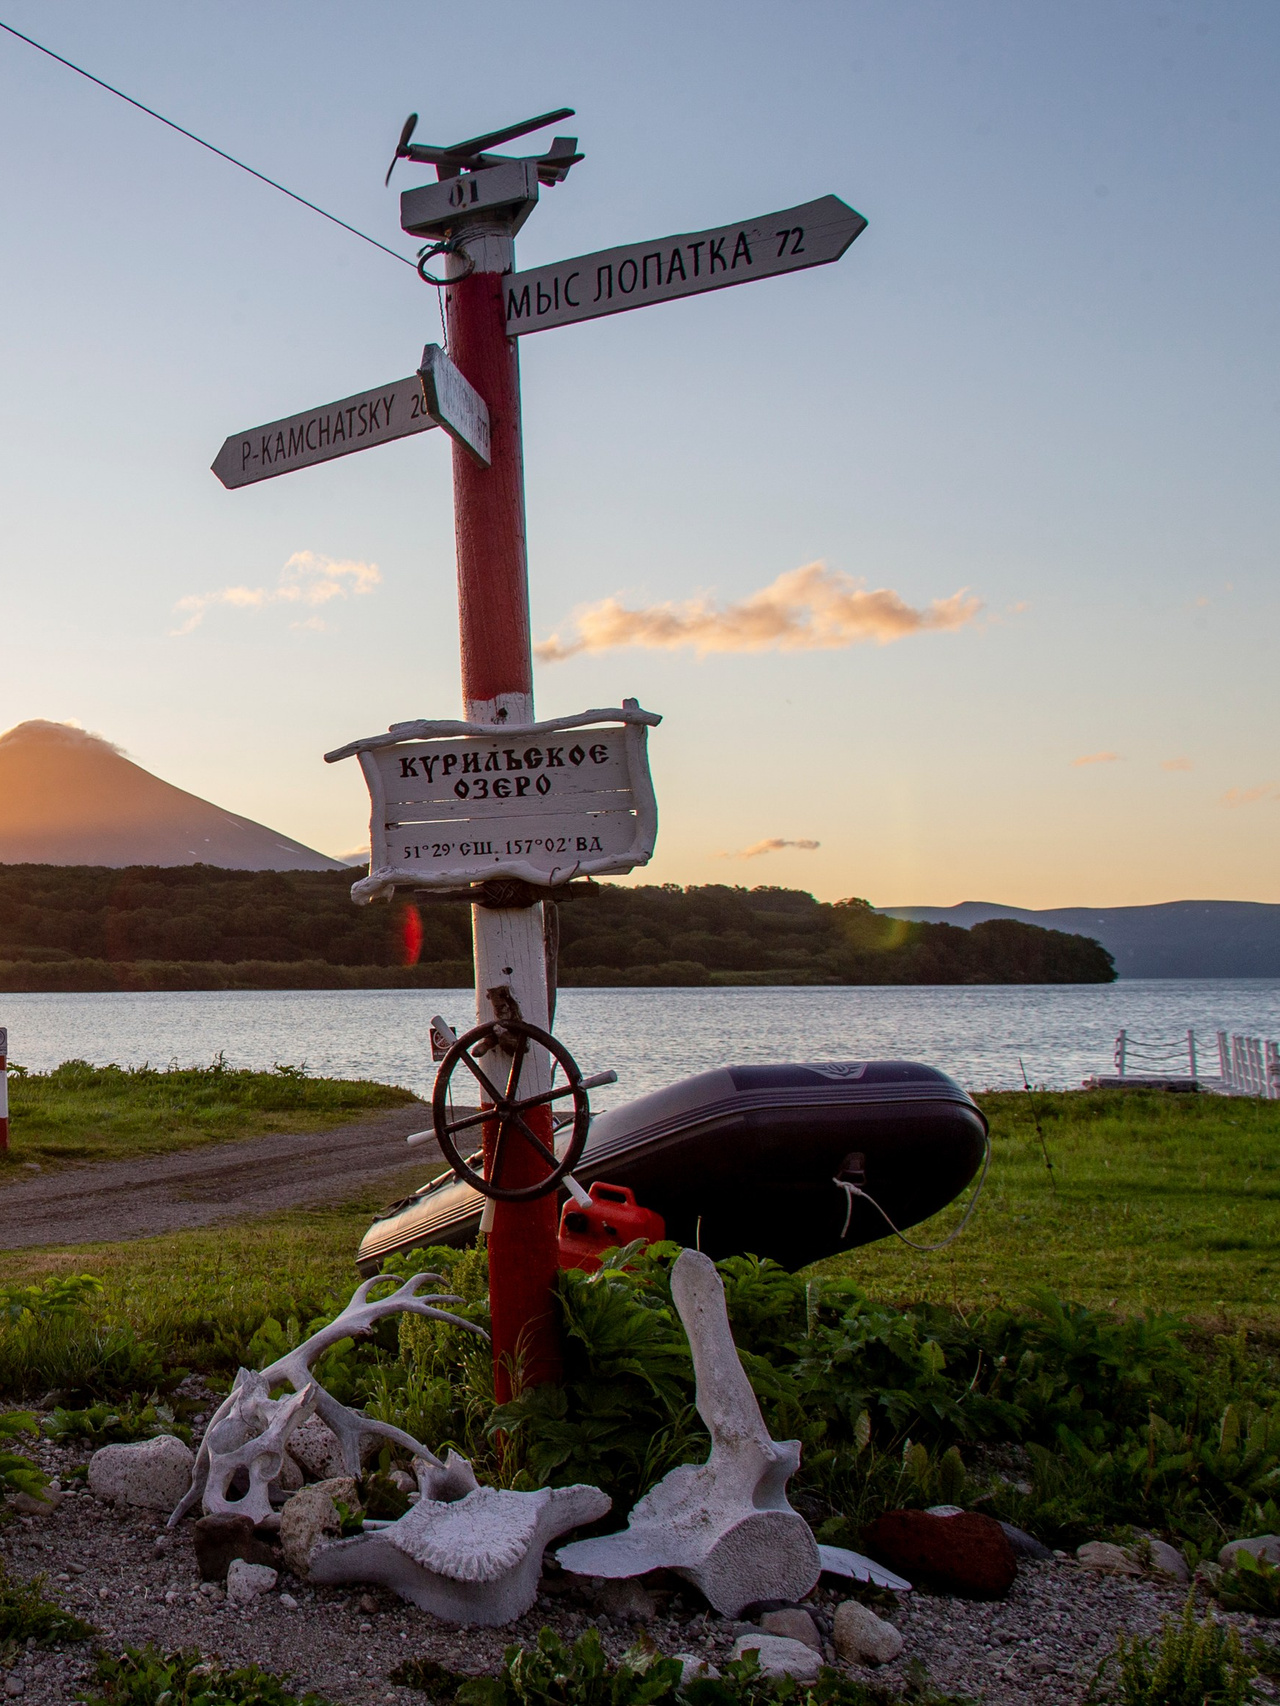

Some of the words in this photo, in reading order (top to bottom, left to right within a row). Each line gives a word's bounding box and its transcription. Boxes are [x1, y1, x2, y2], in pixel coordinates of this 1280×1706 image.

[506, 272, 580, 321] МЫС
[593, 231, 753, 303] ЛОПАТКА
[775, 227, 805, 258] 72
[241, 394, 396, 471] P-KAMCHATSKY
[398, 744, 610, 784] КУРИЛЬСКОЕ
[453, 773, 552, 800] ОЗЕРО
